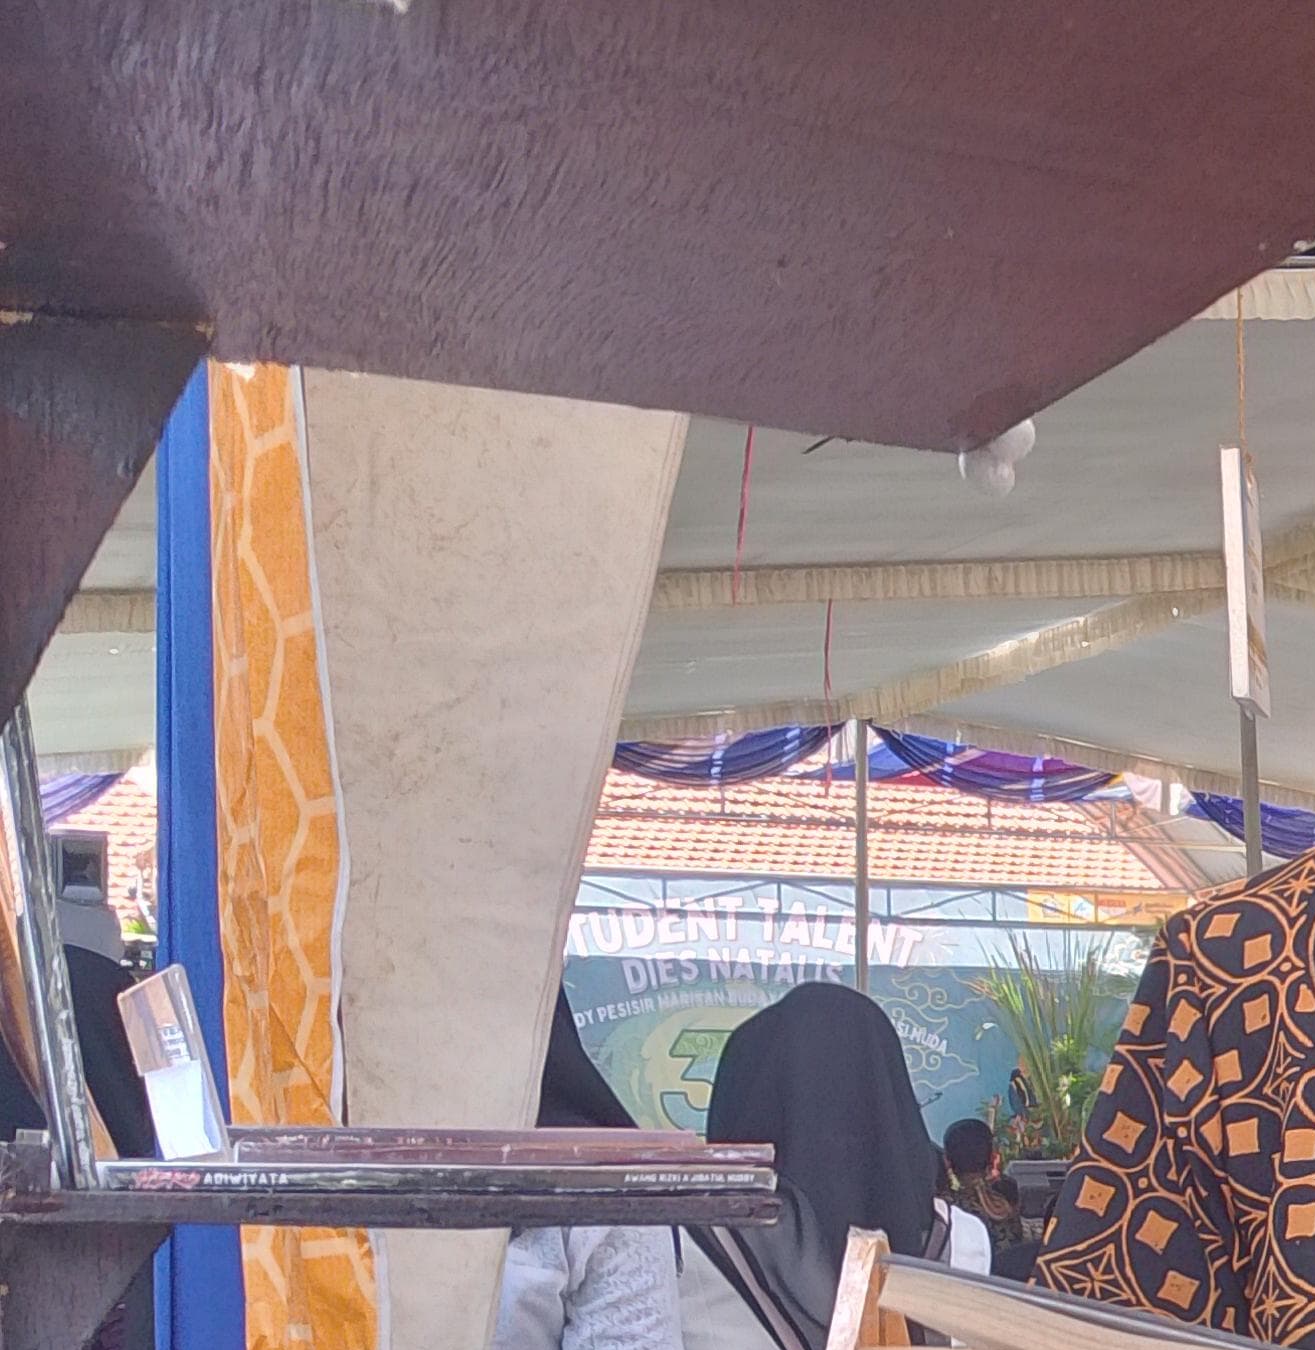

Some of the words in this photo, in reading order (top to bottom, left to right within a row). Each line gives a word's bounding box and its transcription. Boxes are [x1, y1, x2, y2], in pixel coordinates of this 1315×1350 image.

[565, 896, 743, 959] TUDENT
[758, 897, 923, 968] TALENT
[622, 950, 699, 995] DIES
[708, 947, 843, 985] NATALIS
[597, 996, 656, 1023] PESISIR
